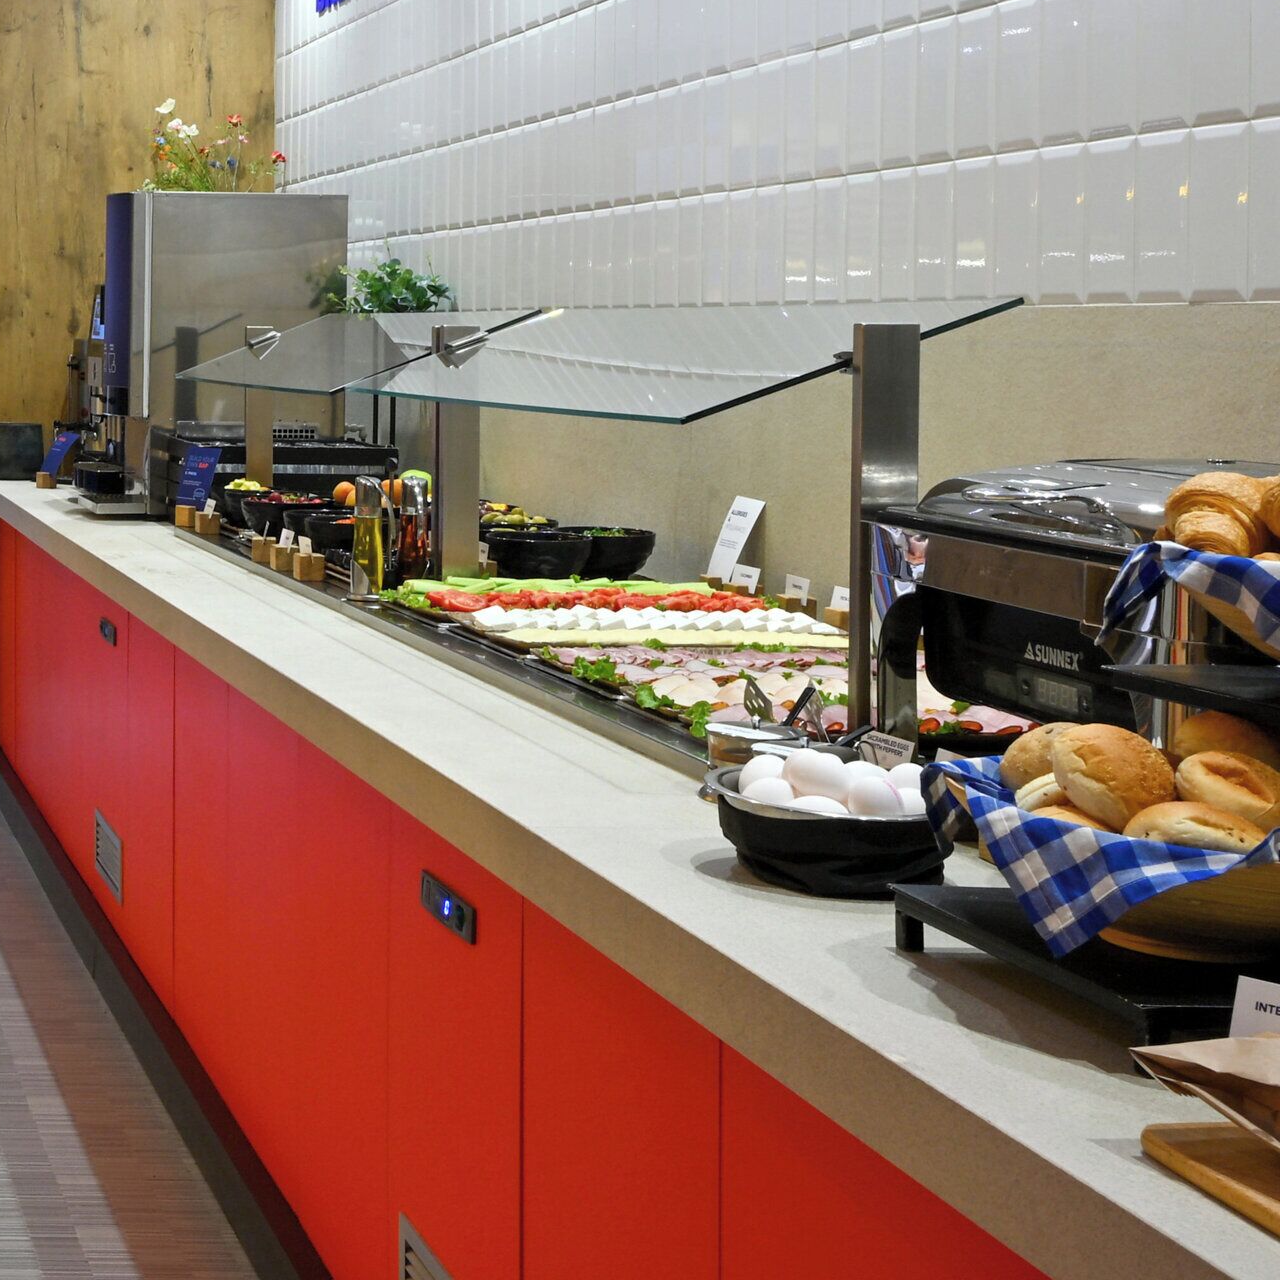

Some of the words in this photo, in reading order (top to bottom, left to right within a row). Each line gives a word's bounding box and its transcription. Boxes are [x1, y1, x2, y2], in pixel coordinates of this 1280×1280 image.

[883, 745, 904, 757] PEPPERS
[897, 741, 910, 752] EGGS
[1255, 1001, 1280, 1017] INTE
